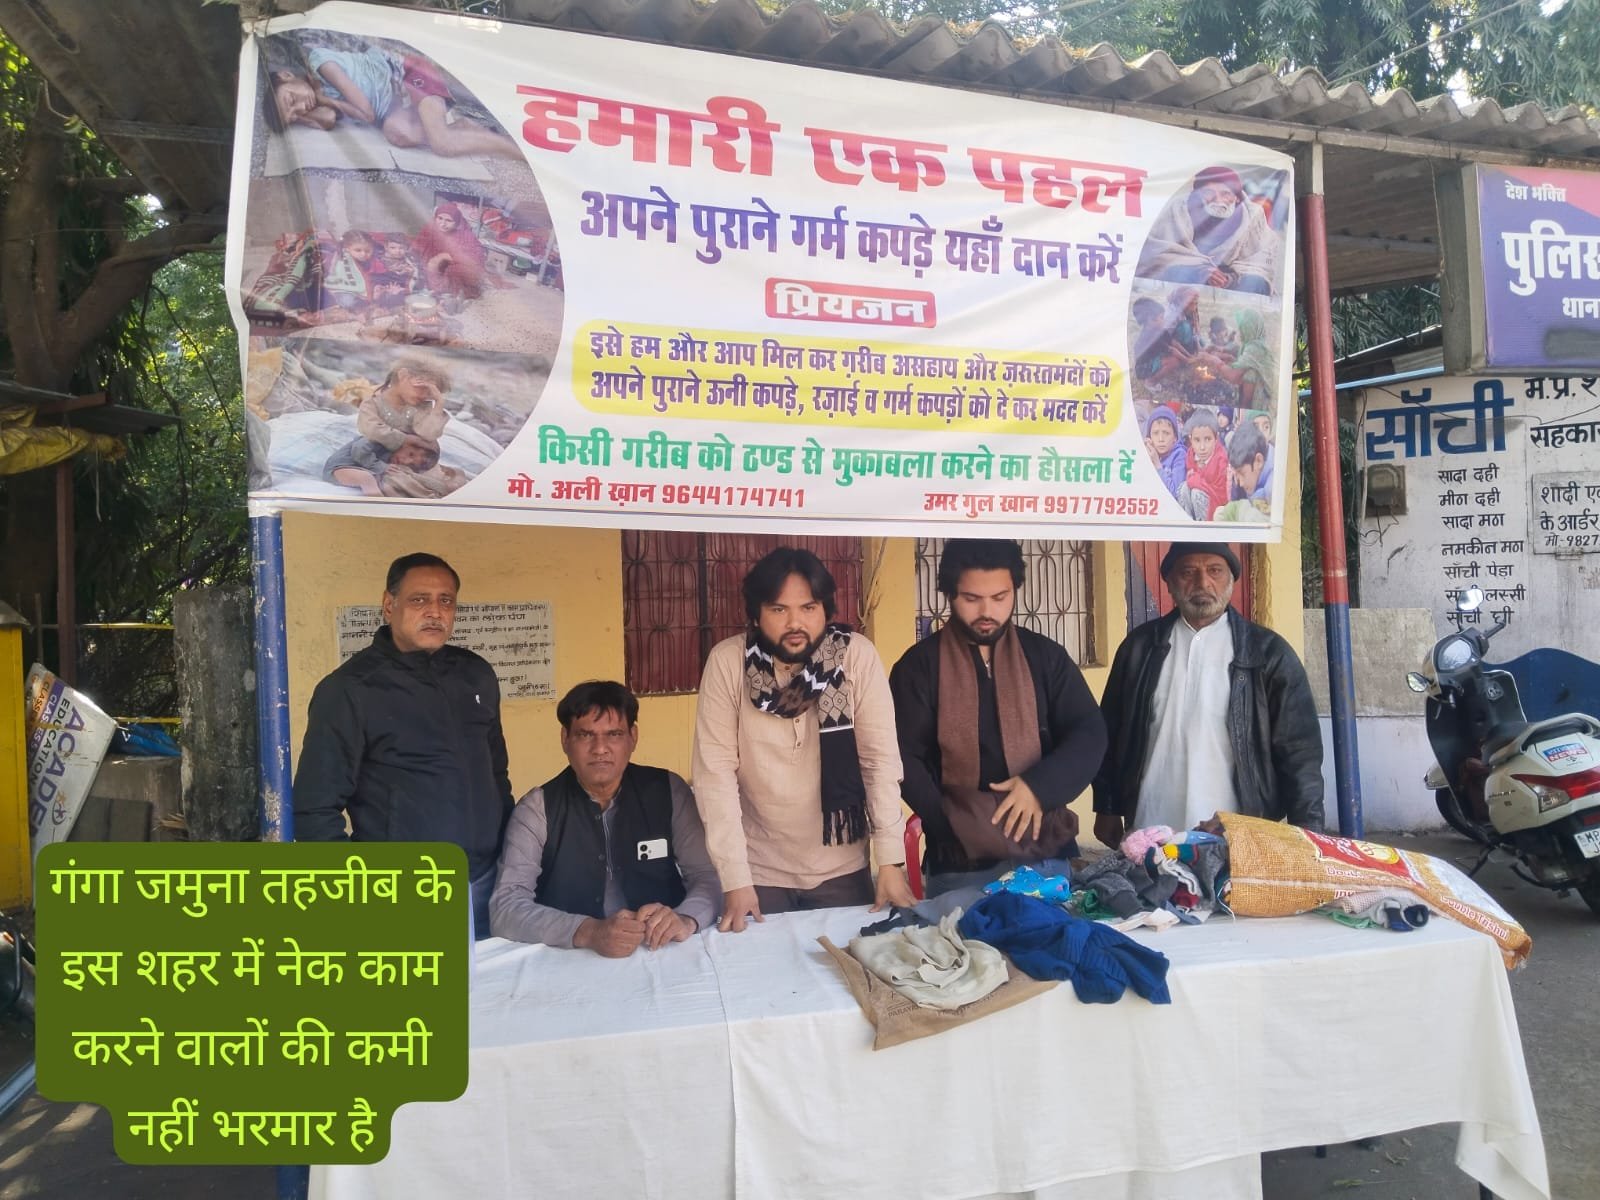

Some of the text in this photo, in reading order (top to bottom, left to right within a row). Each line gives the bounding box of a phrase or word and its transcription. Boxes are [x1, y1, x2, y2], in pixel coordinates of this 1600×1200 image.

[516, 85, 1148, 217] हमारी एक पहल
[1504, 179, 1529, 200] देश
[580, 186, 1123, 284] अपने पुराने गर्म कपड़े यहाँ दान करें
[774, 282, 927, 323] प्रियजन
[1562, 297, 1600, 318] थान
[590, 326, 624, 359] इसे
[630, 335, 661, 359] हम
[668, 333, 708, 363] और
[714, 338, 757, 366] आप
[762, 339, 803, 369] मिल
[809, 349, 836, 371] कर
[892, 353, 959, 379] असहाय
[965, 353, 996, 381] और
[1089, 361, 1112, 387] को
[591, 365, 1108, 424] अपने पुराने ऊनी कपड़े, रज़ाई व गर्म कपड़ों को दे कर मदद करें
[1530, 421, 1600, 448] सहका
[538, 424, 1136, 486] किसी गरीब को ठण्ड से मुकाबला करने का हौसला दें
[1438, 462, 1500, 484] सादा दही
[508, 473, 541, 498] मो.
[551, 476, 602, 501] अली
[662, 484, 805, 508] 9644174741
[1438, 487, 1500, 506] मीठा दही
[1541, 481, 1581, 505] शादी
[923, 492, 957, 512] उमर
[963, 494, 994, 519] गुल
[1043, 495, 1159, 516] 9977792552
[1441, 515, 1474, 530] सादा
[1540, 508, 1600, 531] के आर्डर
[1441, 538, 1498, 556] नमकीन
[1485, 583, 1526, 602] लस्सी
[1490, 605, 1515, 625] घी
[28, 705, 85, 838] ACADE
[1585, 830, 1600, 843] MP
